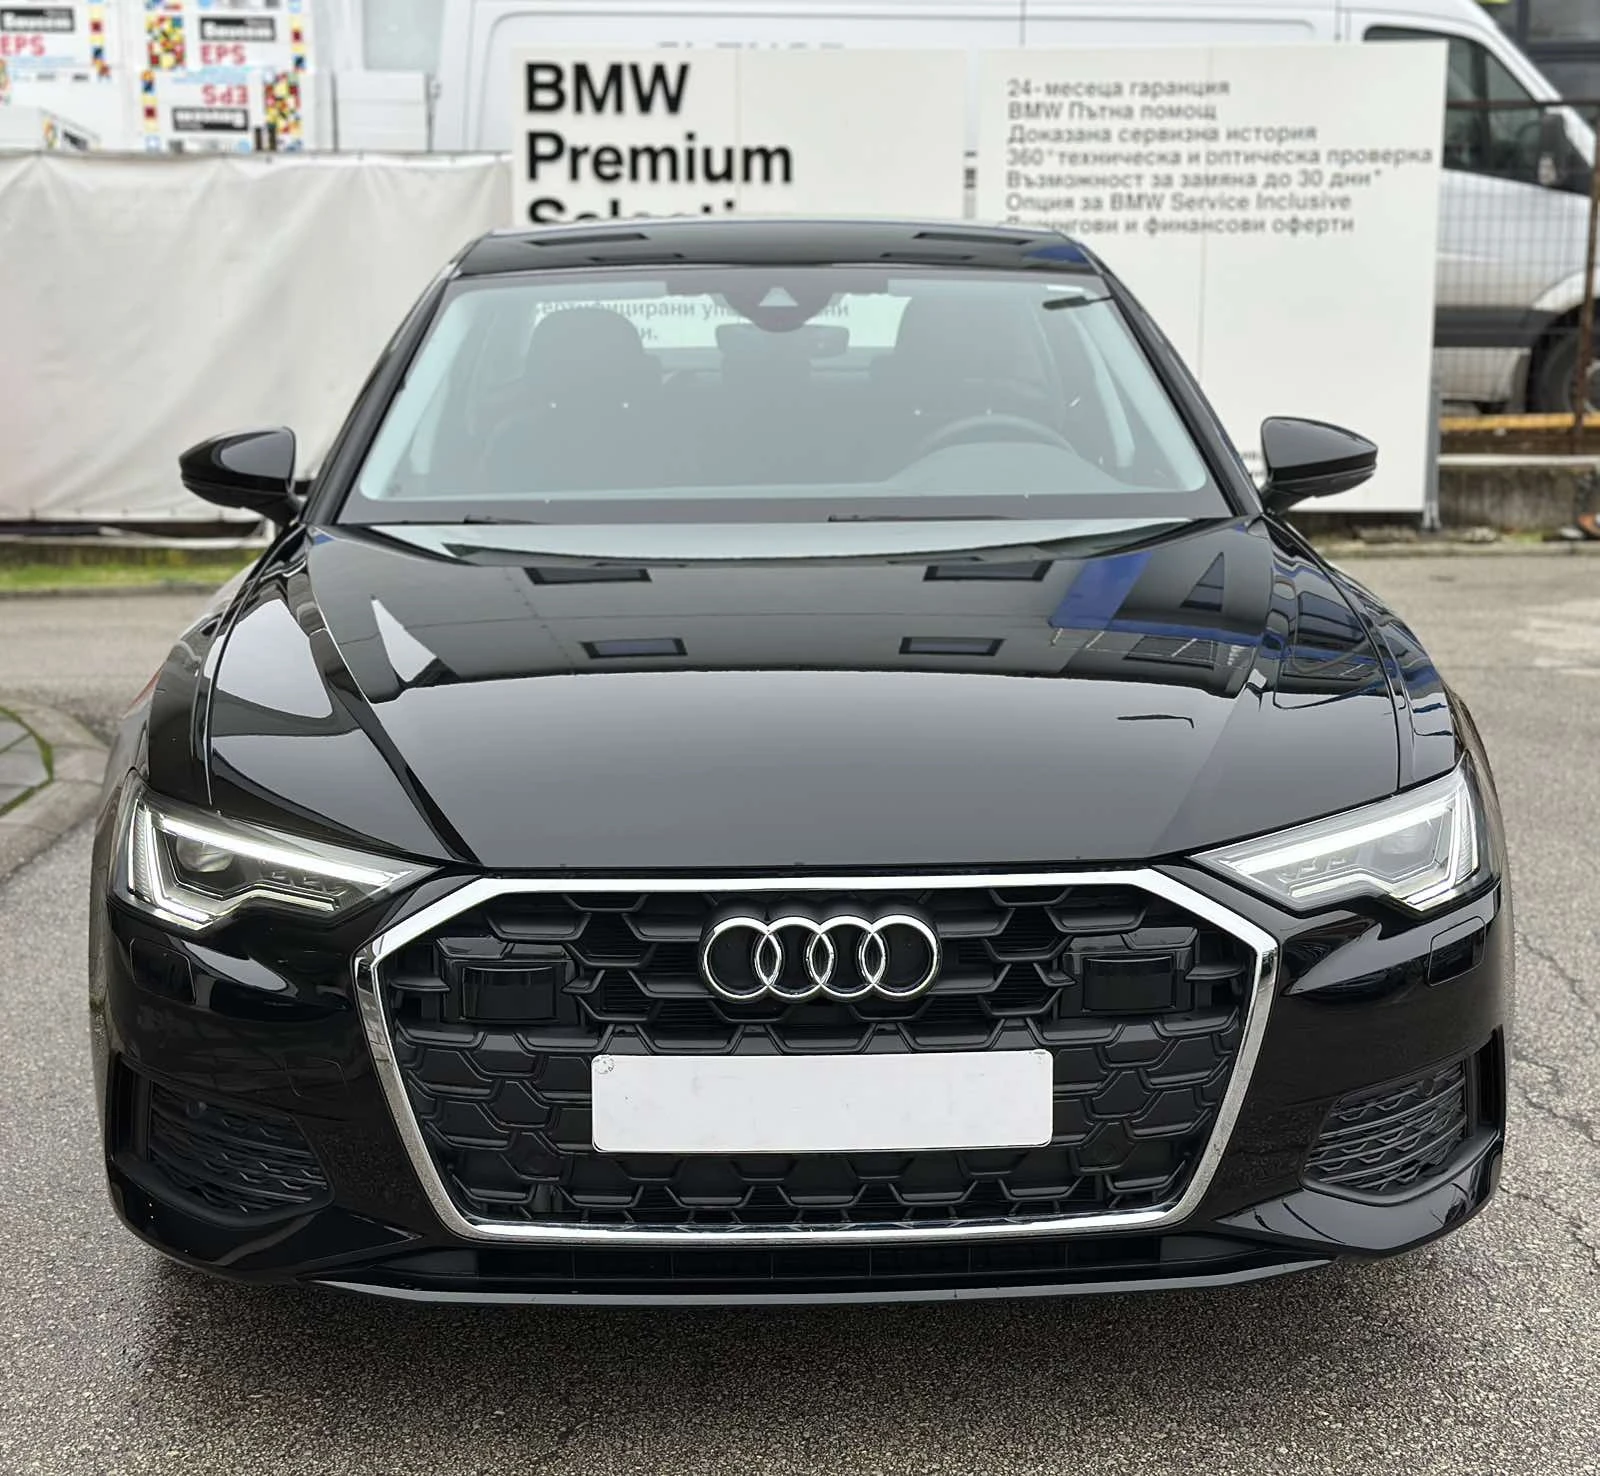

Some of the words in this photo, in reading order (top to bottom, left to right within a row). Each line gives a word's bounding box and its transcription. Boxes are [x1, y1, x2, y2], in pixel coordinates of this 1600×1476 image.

[524, 62, 690, 115] BMW
[1129, 81, 1231, 101] гаранция
[1007, 101, 1063, 120] BMW
[1068, 101, 1135, 120] Пътна
[1140, 104, 1218, 121] помощ
[1006, 123, 1113, 145] Доказана
[1117, 127, 1220, 146] сервизна
[1225, 126, 1318, 146] история
[525, 130, 793, 184] Premium
[1058, 150, 1182, 167] техническа
[1187, 151, 1201, 166] и
[1205, 149, 1321, 167] оптическа
[1326, 149, 1434, 168] проверка
[1006, 169, 1144, 189] Възможност
[1151, 173, 1174, 189] за
[1181, 172, 1258, 189] замяна
[1262, 172, 1293, 190] до
[1298, 169, 1325, 188] 30
[1006, 192, 1075, 213] Опция
[1081, 196, 1104, 211] за
[1109, 192, 1165, 212] BMW
[1171, 192, 1250, 211] Service
[1255, 191, 1353, 212] Inclusive
[1124, 218, 1139, 233] и
[1143, 215, 1266, 236] финансови
[1271, 215, 1355, 236] оферти
